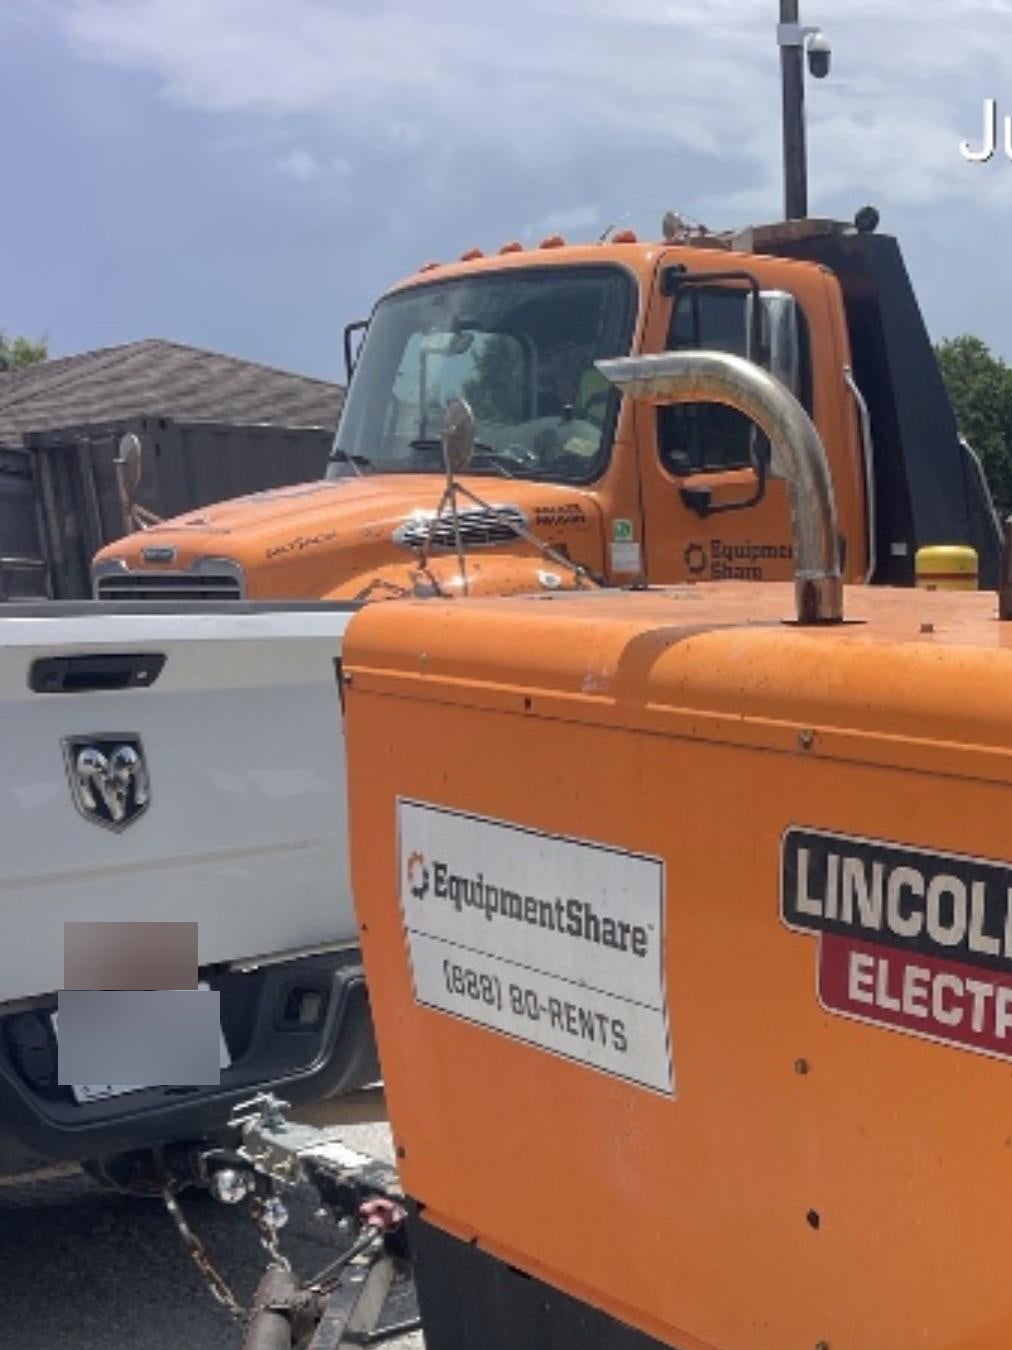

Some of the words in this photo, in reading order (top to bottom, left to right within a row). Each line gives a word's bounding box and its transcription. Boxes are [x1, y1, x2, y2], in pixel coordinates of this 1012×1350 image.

[711, 540, 793, 561] Equipme
[433, 861, 650, 958] EquipmentShare
[442, 959, 502, 1011] (888)
[508, 983, 628, 1051] 80-RENTS
